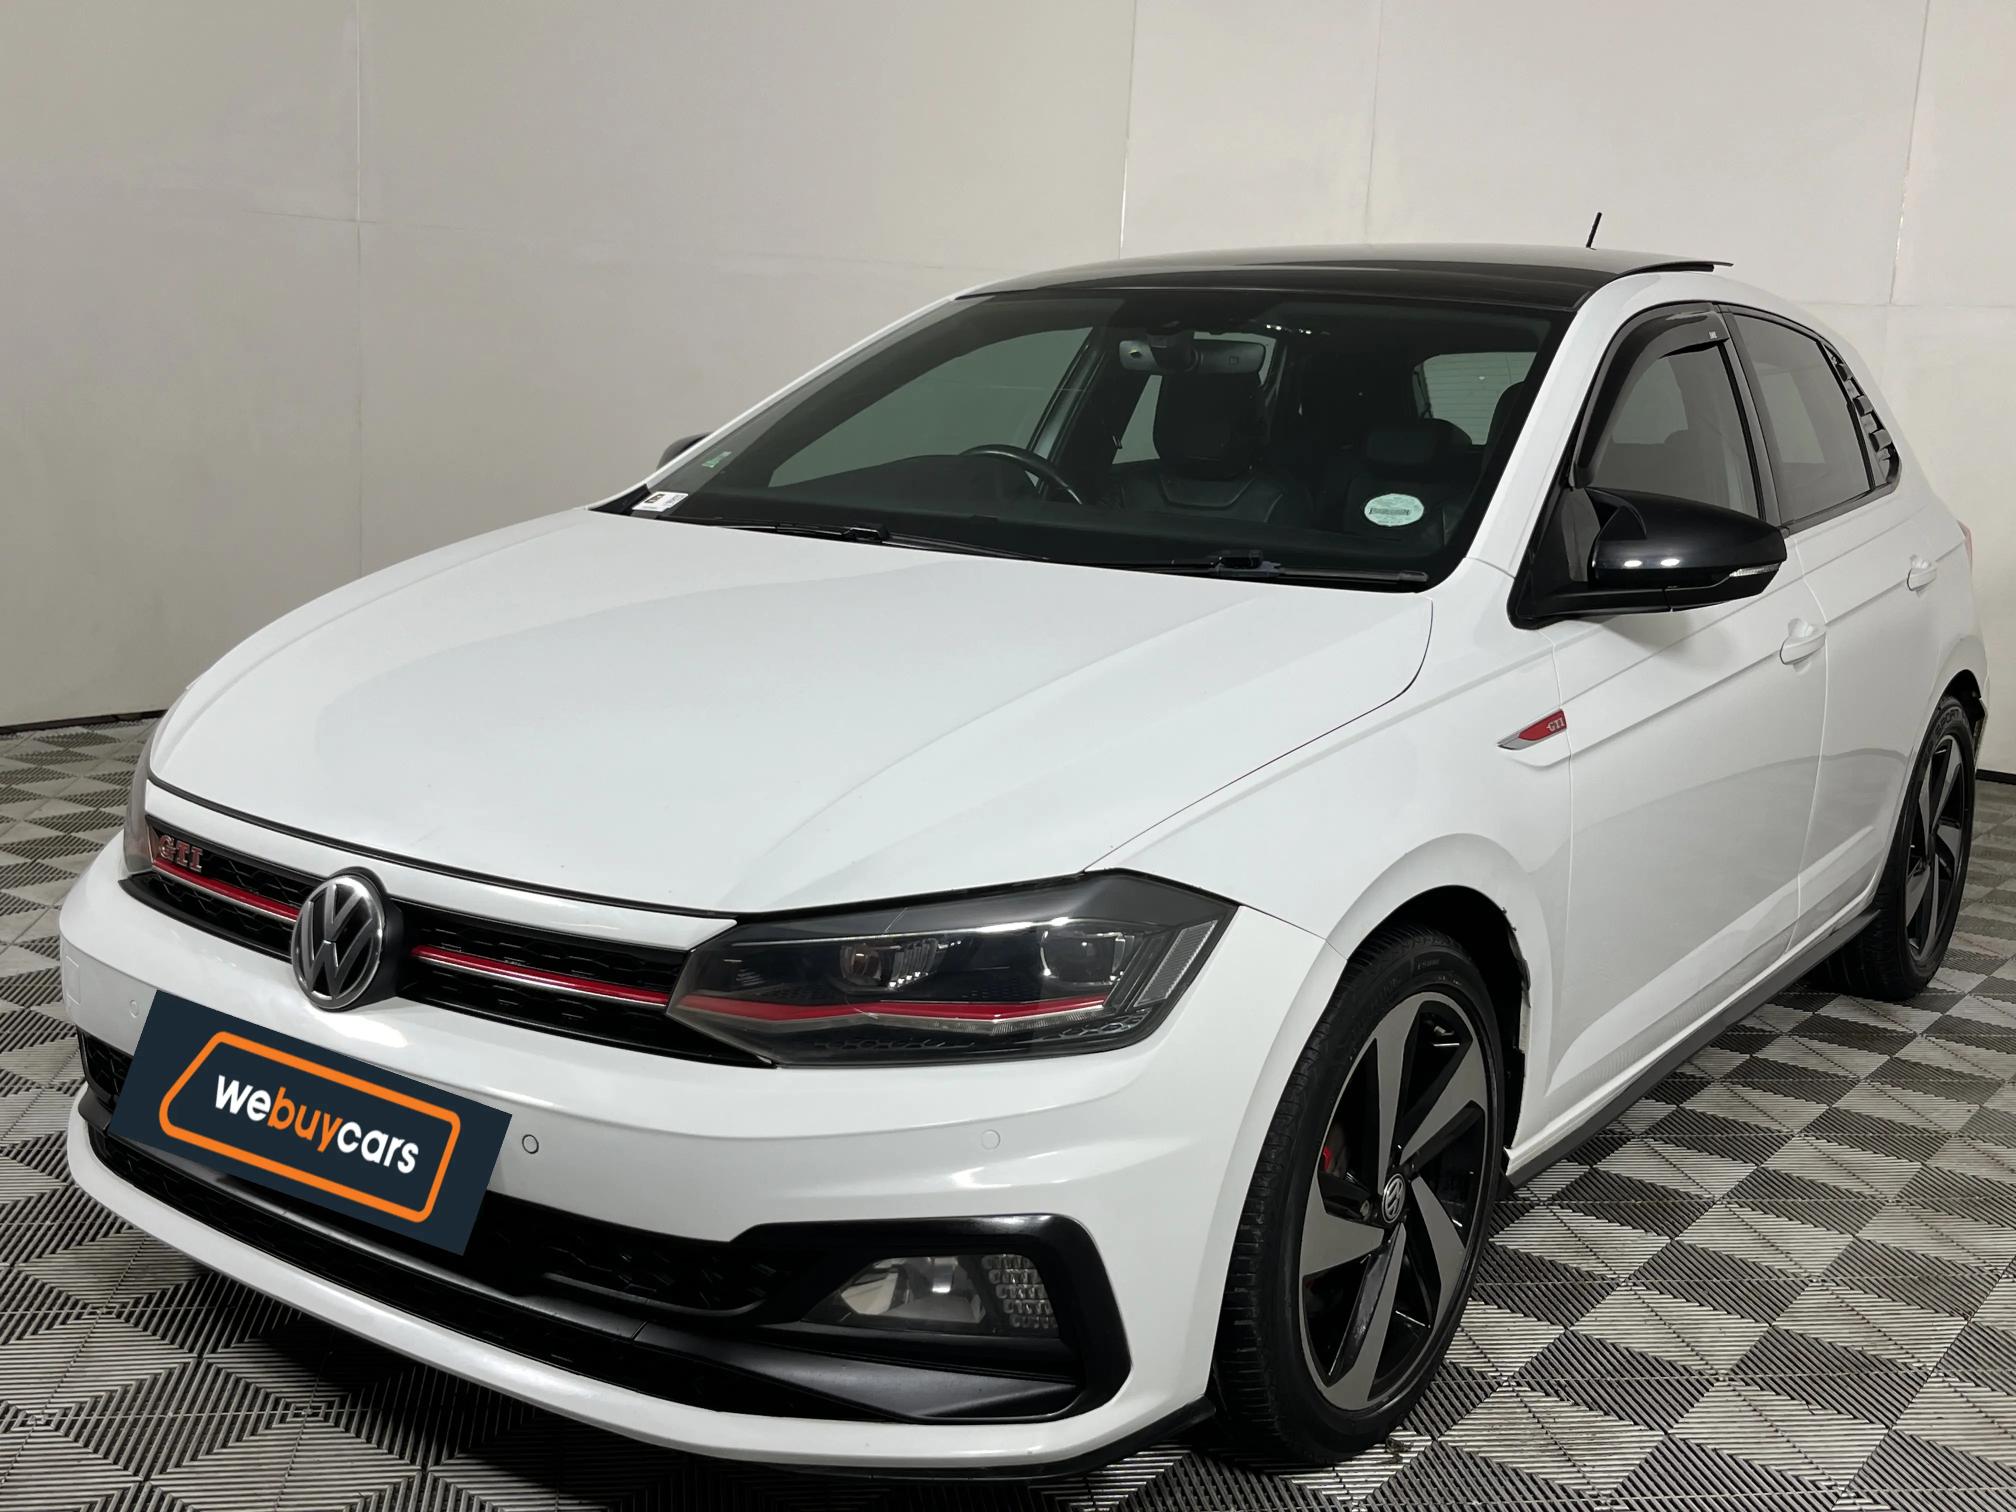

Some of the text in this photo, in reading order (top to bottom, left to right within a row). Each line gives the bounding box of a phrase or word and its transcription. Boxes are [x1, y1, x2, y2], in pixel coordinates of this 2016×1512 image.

[1546, 717, 1565, 732] GTI
[159, 834, 203, 873] GTI
[295, 878, 380, 1006] VW
